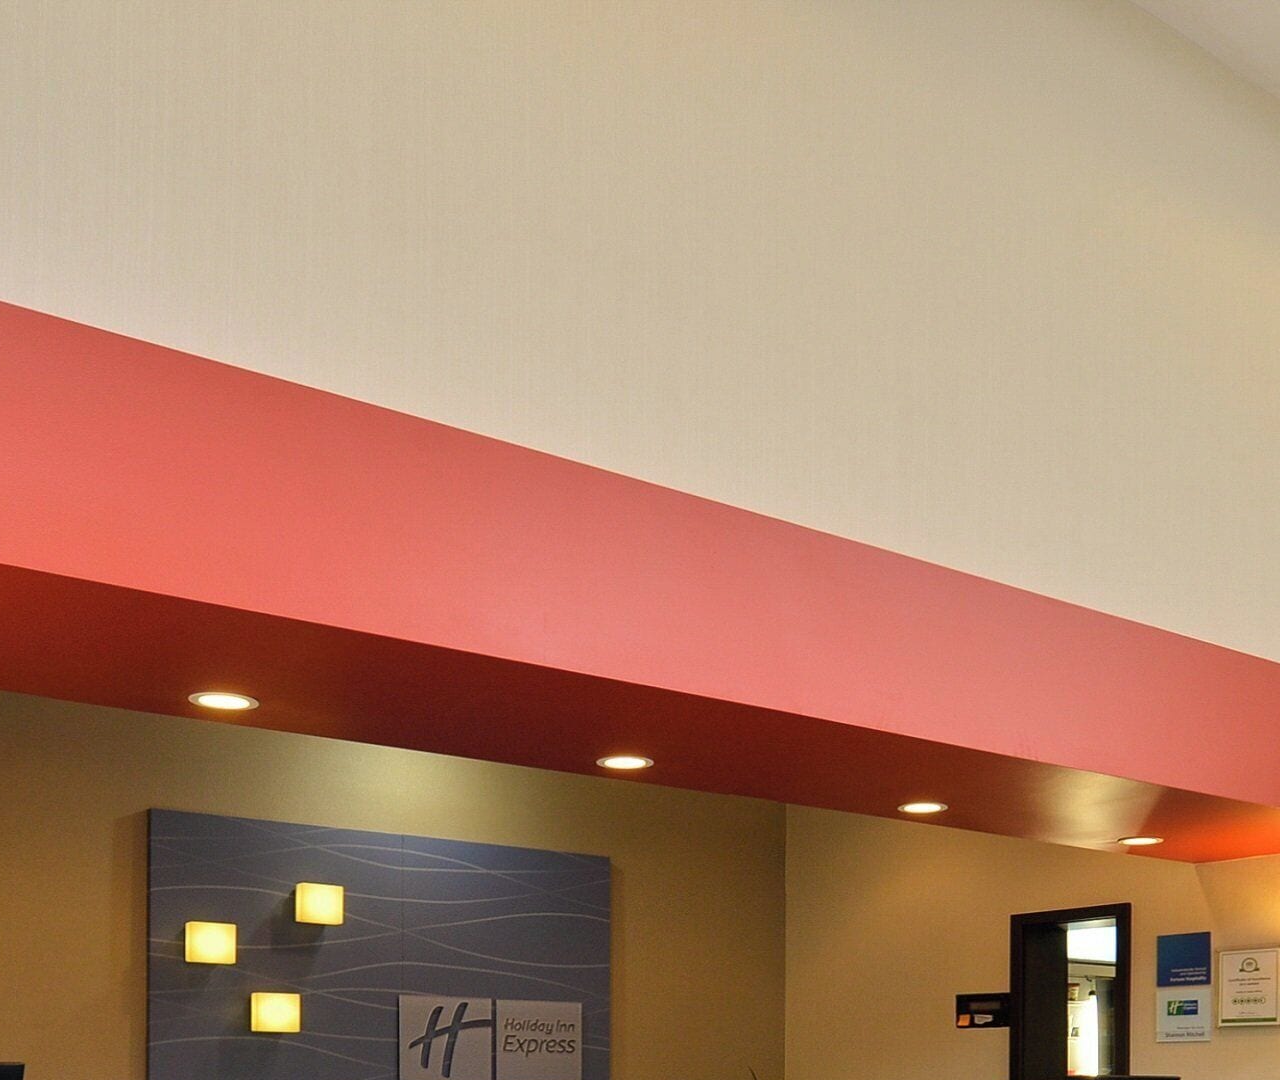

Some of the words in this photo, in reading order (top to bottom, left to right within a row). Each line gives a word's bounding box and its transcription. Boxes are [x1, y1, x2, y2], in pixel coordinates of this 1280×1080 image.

[504, 1018, 552, 1035] Holiday
[556, 1019, 576, 1033] Inn
[503, 1035, 576, 1058] Express
